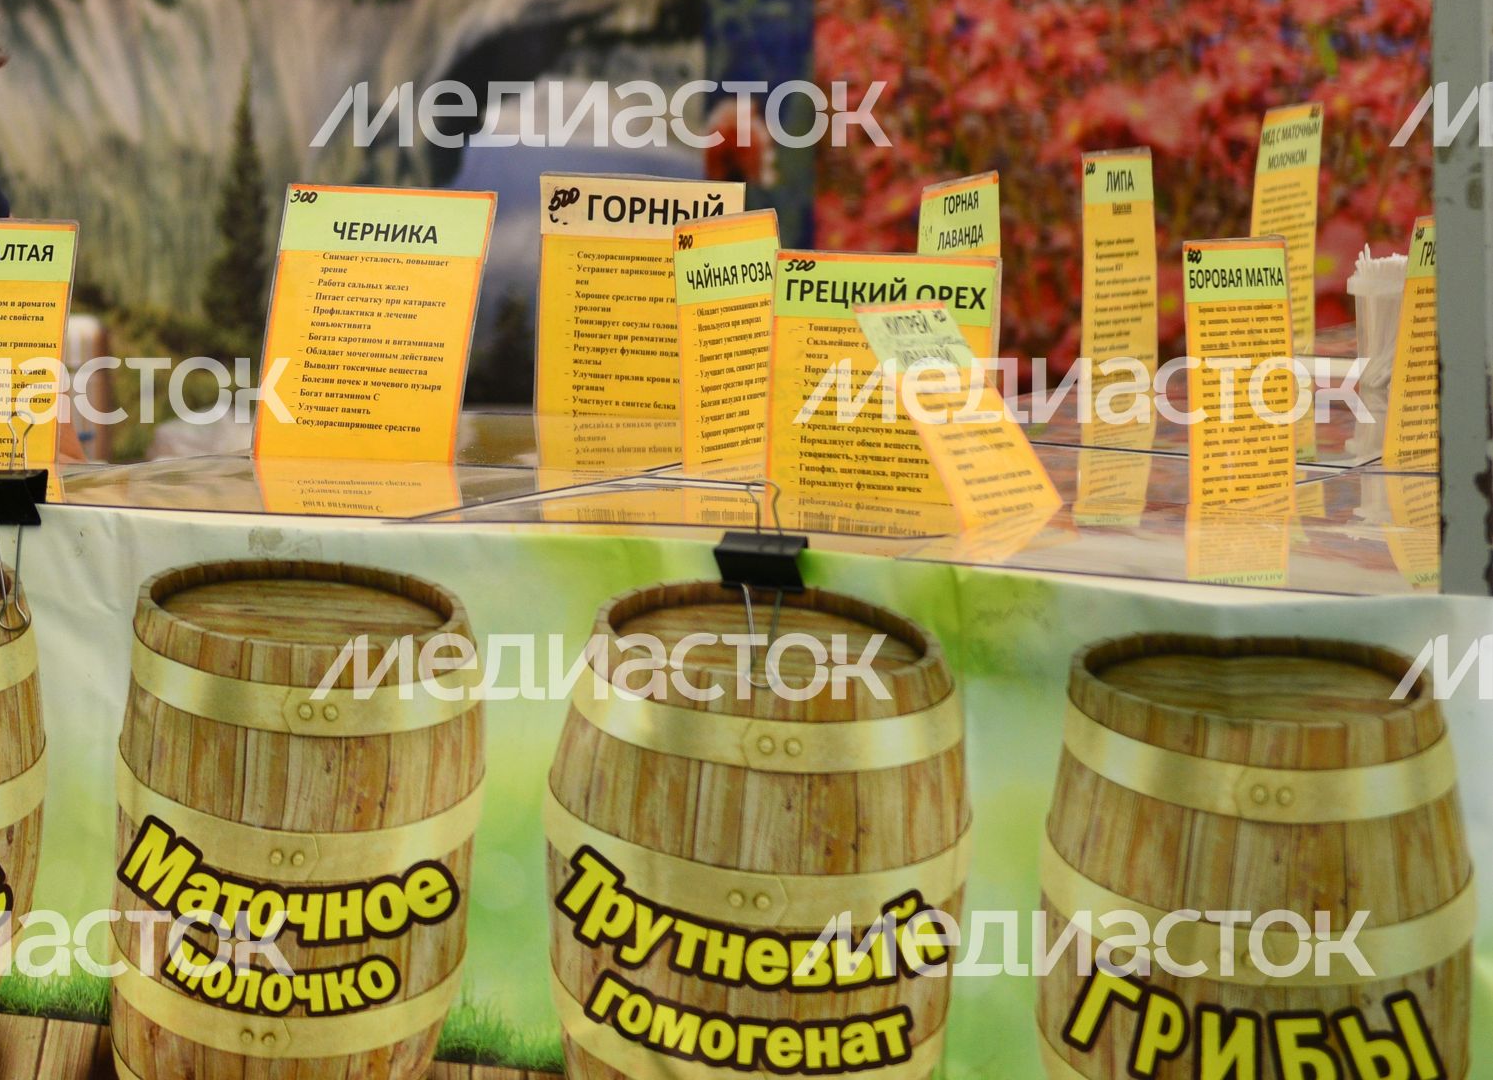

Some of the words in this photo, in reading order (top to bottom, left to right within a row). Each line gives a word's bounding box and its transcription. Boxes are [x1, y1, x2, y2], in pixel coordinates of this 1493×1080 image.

[1282, 120, 1320, 142] МАТОЧНЫМ
[1268, 149, 1308, 169] МОЛОЧКОМ
[1106, 169, 1134, 193] ЛИПА
[290, 189, 318, 204] 300
[944, 190, 979, 216] ГОРНАЯ
[588, 194, 725, 225] ГОРНЫЙ
[333, 221, 438, 244] ЧЕРНИКА
[937, 224, 983, 251] ЛАВАНДА
[678, 234, 693, 250] 700
[323, 252, 358, 261] Снимает
[406, 259, 449, 267] повышает
[784, 258, 816, 272] 500
[321, 266, 347, 274] зрение
[620, 268, 666, 276] варикозное
[687, 262, 739, 290] ЧАЙНАЯ
[742, 261, 773, 284] РОЗА
[317, 279, 345, 288] Работа
[1189, 268, 1243, 289] БОРОВАЯ
[1246, 267, 1284, 287] МАТКА
[315, 292, 344, 301] Питает
[347, 296, 382, 304] сетчатку
[403, 300, 446, 308] катаракте
[575, 290, 610, 300] Хорошее
[786, 277, 907, 309] ГРЕЦКИЙ
[916, 284, 986, 310] ОРЕХ
[313, 306, 374, 317] Профилактика
[384, 312, 417, 320] лечение
[574, 305, 611, 313] урологии
[574, 317, 620, 328] Тонизирует
[622, 321, 650, 329] сосуды
[309, 333, 335, 342] Богата
[338, 336, 382, 344] каротином
[574, 330, 611, 340] Помогает
[614, 334, 628, 342] при
[306, 347, 344, 356] Обладает
[346, 351, 398, 359] мочегонным
[400, 354, 444, 362] действием
[573, 344, 618, 355] Регулирует
[620, 347, 657, 356] функцию
[806, 352, 828, 360] мозга
[304, 361, 340, 370] Выводит
[343, 365, 386, 373] токсичные
[389, 368, 428, 376] вещества
[302, 375, 334, 384] Болезни
[371, 381, 409, 389] мочевого
[411, 383, 441, 392] пузыря
[573, 370, 613, 380] Улучшает
[615, 374, 644, 382] прилив
[646, 376, 670, 384] крови
[300, 389, 322, 397] Богат
[325, 391, 371, 400] витамином
[373, 393, 380, 401] С
[572, 383, 605, 392] органам
[298, 403, 338, 413] Улучшает
[572, 396, 613, 407] Участвует
[653, 401, 676, 410] белка
[296, 417, 382, 430] Сосудорасширяющее
[385, 424, 420, 433] средство
[856, 439, 881, 448] обмен
[891, 471, 929, 479] простата
[121, 818, 456, 943] Маточное
[560, 849, 947, 988] Трутневый
[165, 941, 397, 1014] молочко
[589, 975, 910, 1071] гомогенат
